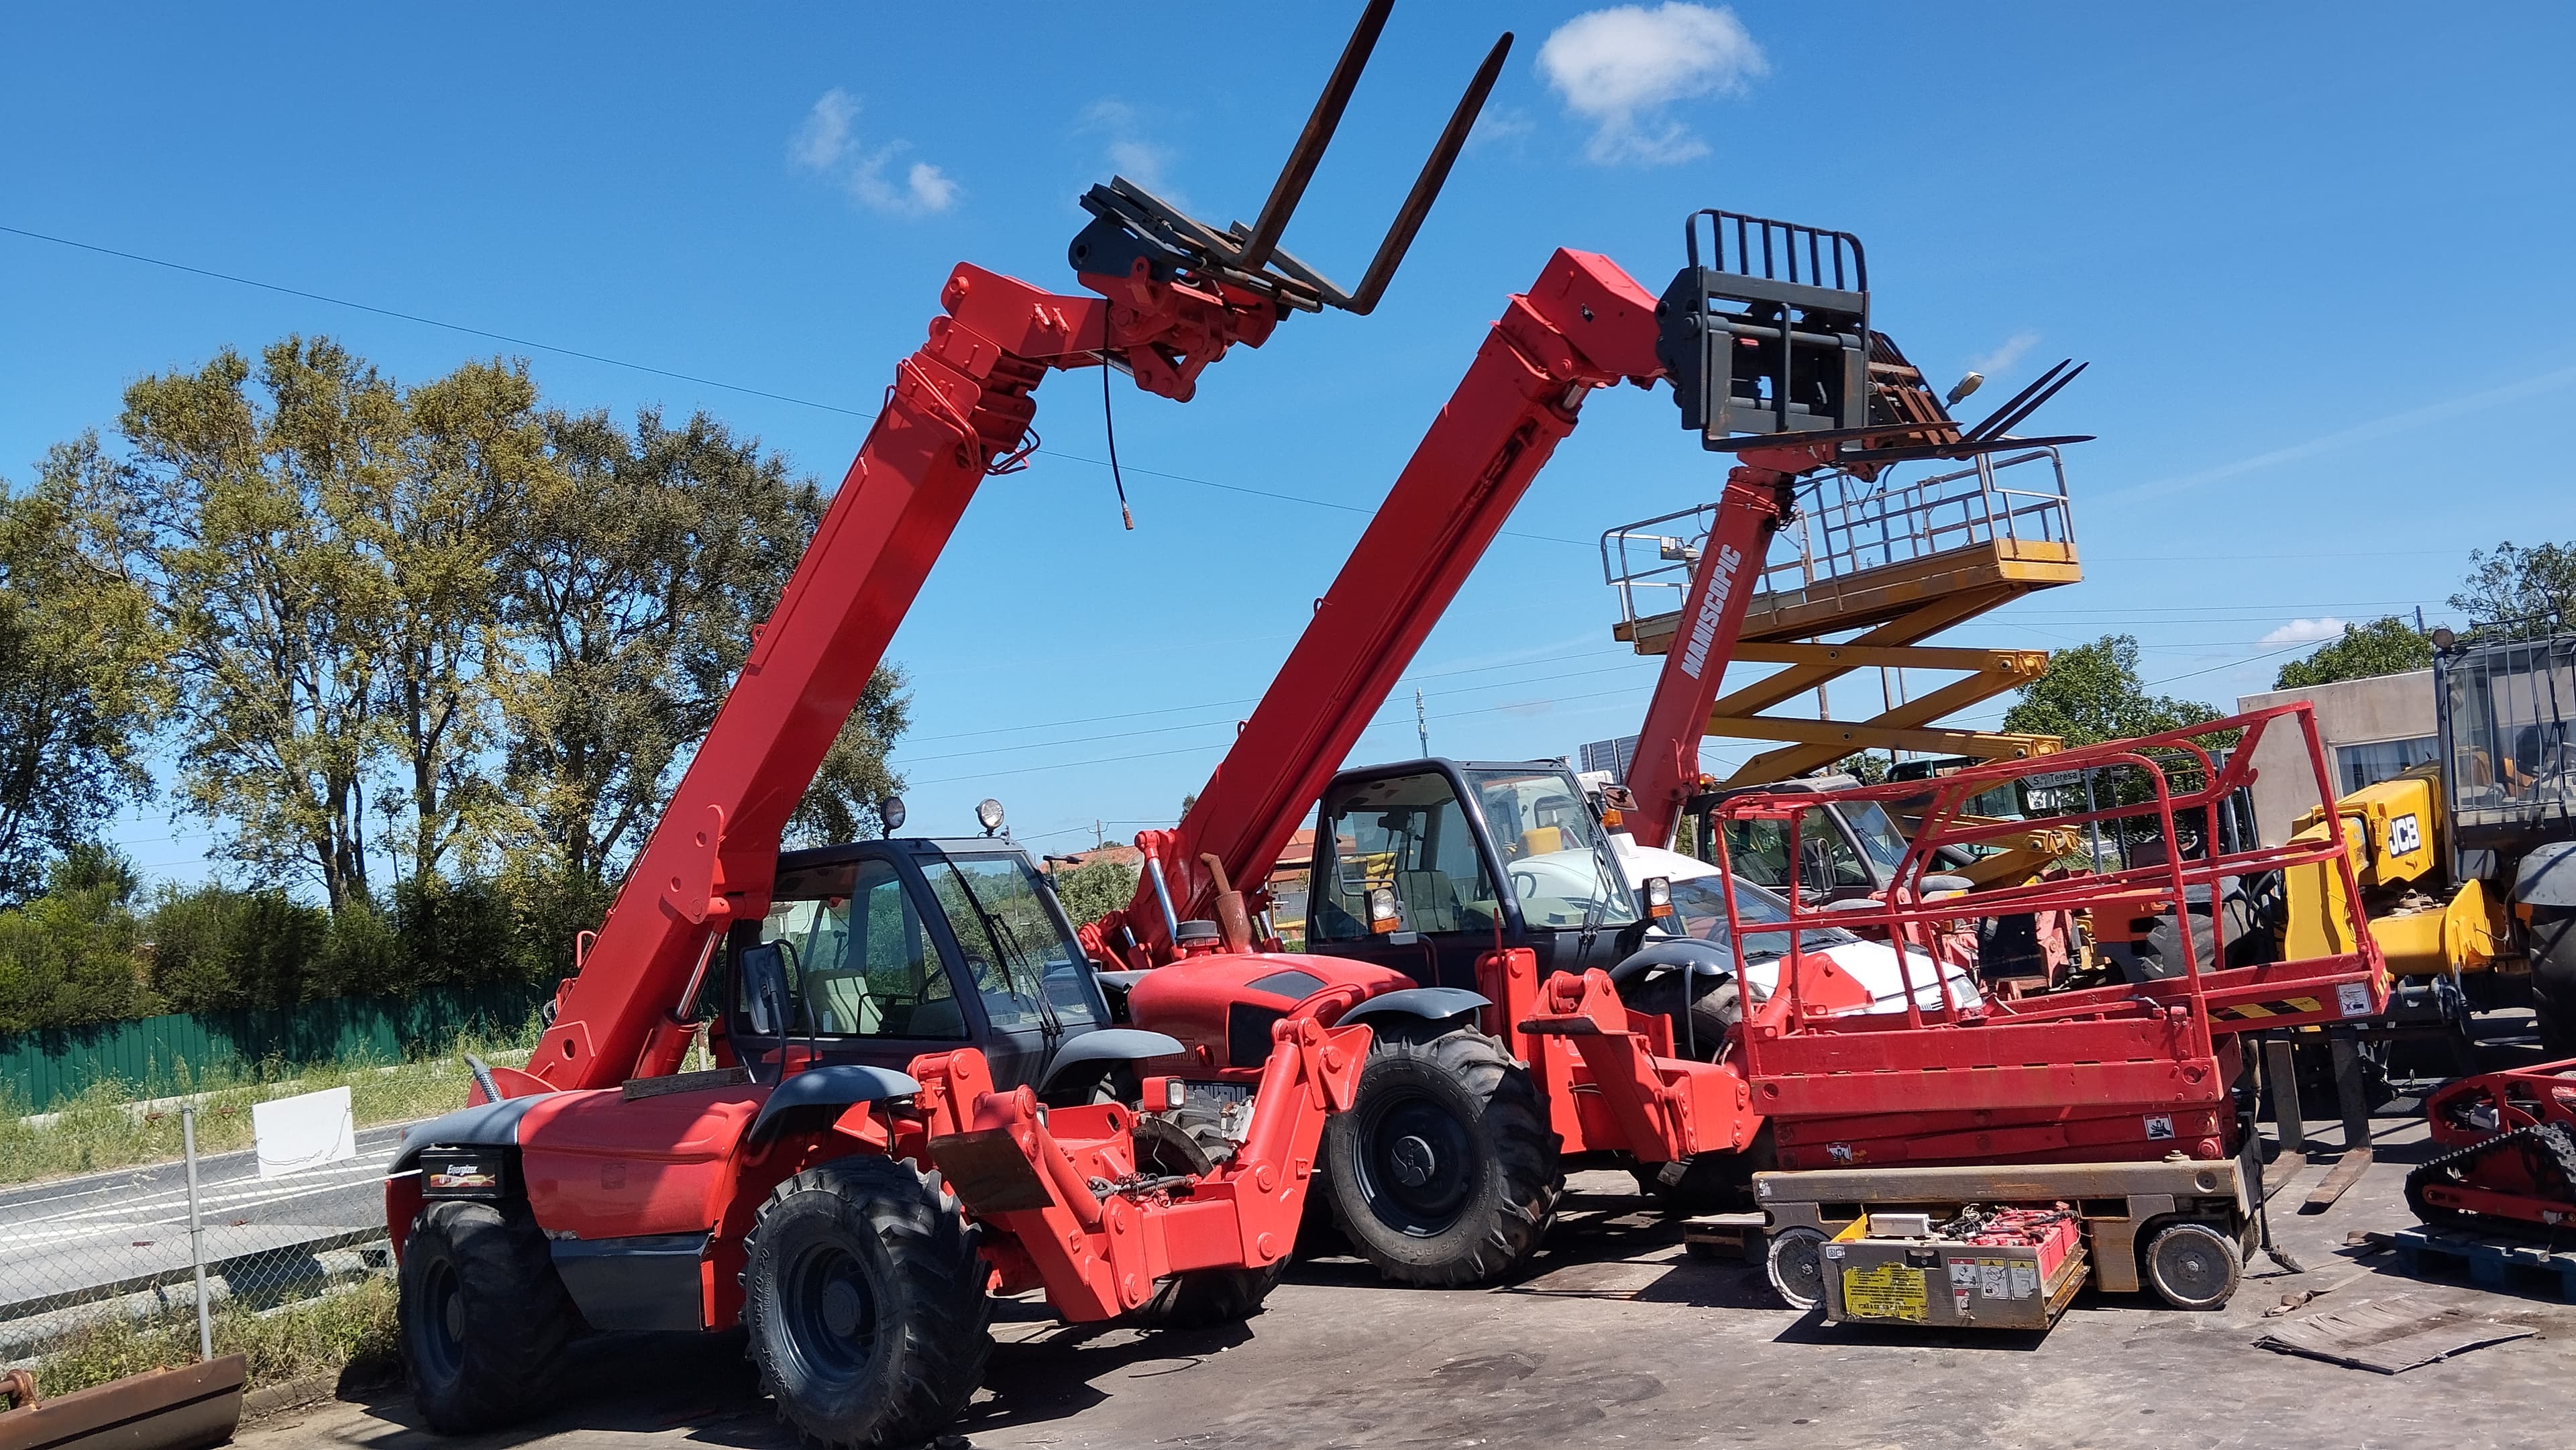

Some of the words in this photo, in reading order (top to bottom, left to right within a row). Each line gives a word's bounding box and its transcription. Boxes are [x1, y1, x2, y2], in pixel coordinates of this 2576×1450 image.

[1680, 544, 1741, 674] MANISCOPIC
[2049, 772, 2078, 783] Teresa
[2389, 815, 2420, 856] JCB
[446, 1164, 478, 1176] Energizer
